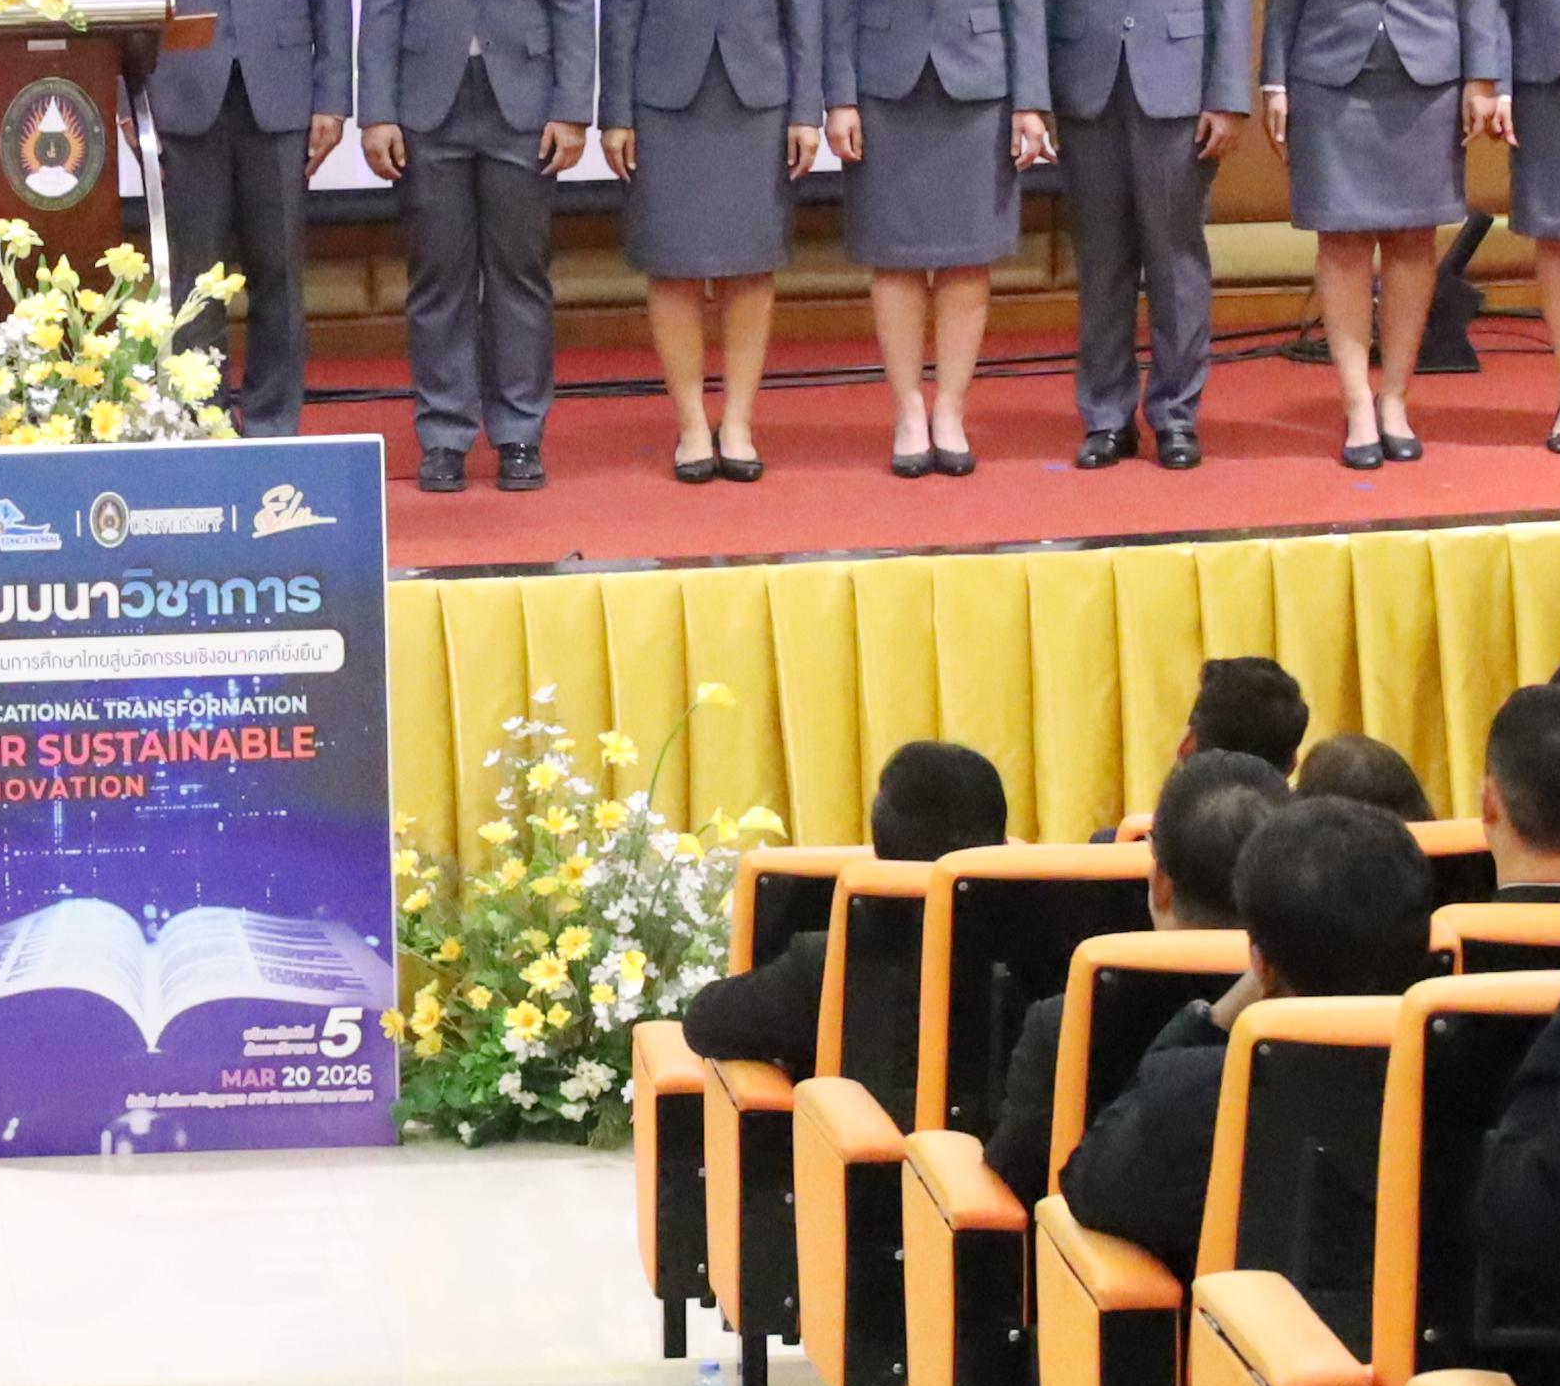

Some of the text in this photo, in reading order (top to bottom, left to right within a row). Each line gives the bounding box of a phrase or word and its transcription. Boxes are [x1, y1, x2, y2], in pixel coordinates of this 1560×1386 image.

[103, 695, 308, 720] TRANSFORMATION
[37, 725, 316, 767] SUSTAINABLE
[319, 1006, 364, 1058] 5
[221, 1064, 372, 1088] MAR 20 2026
